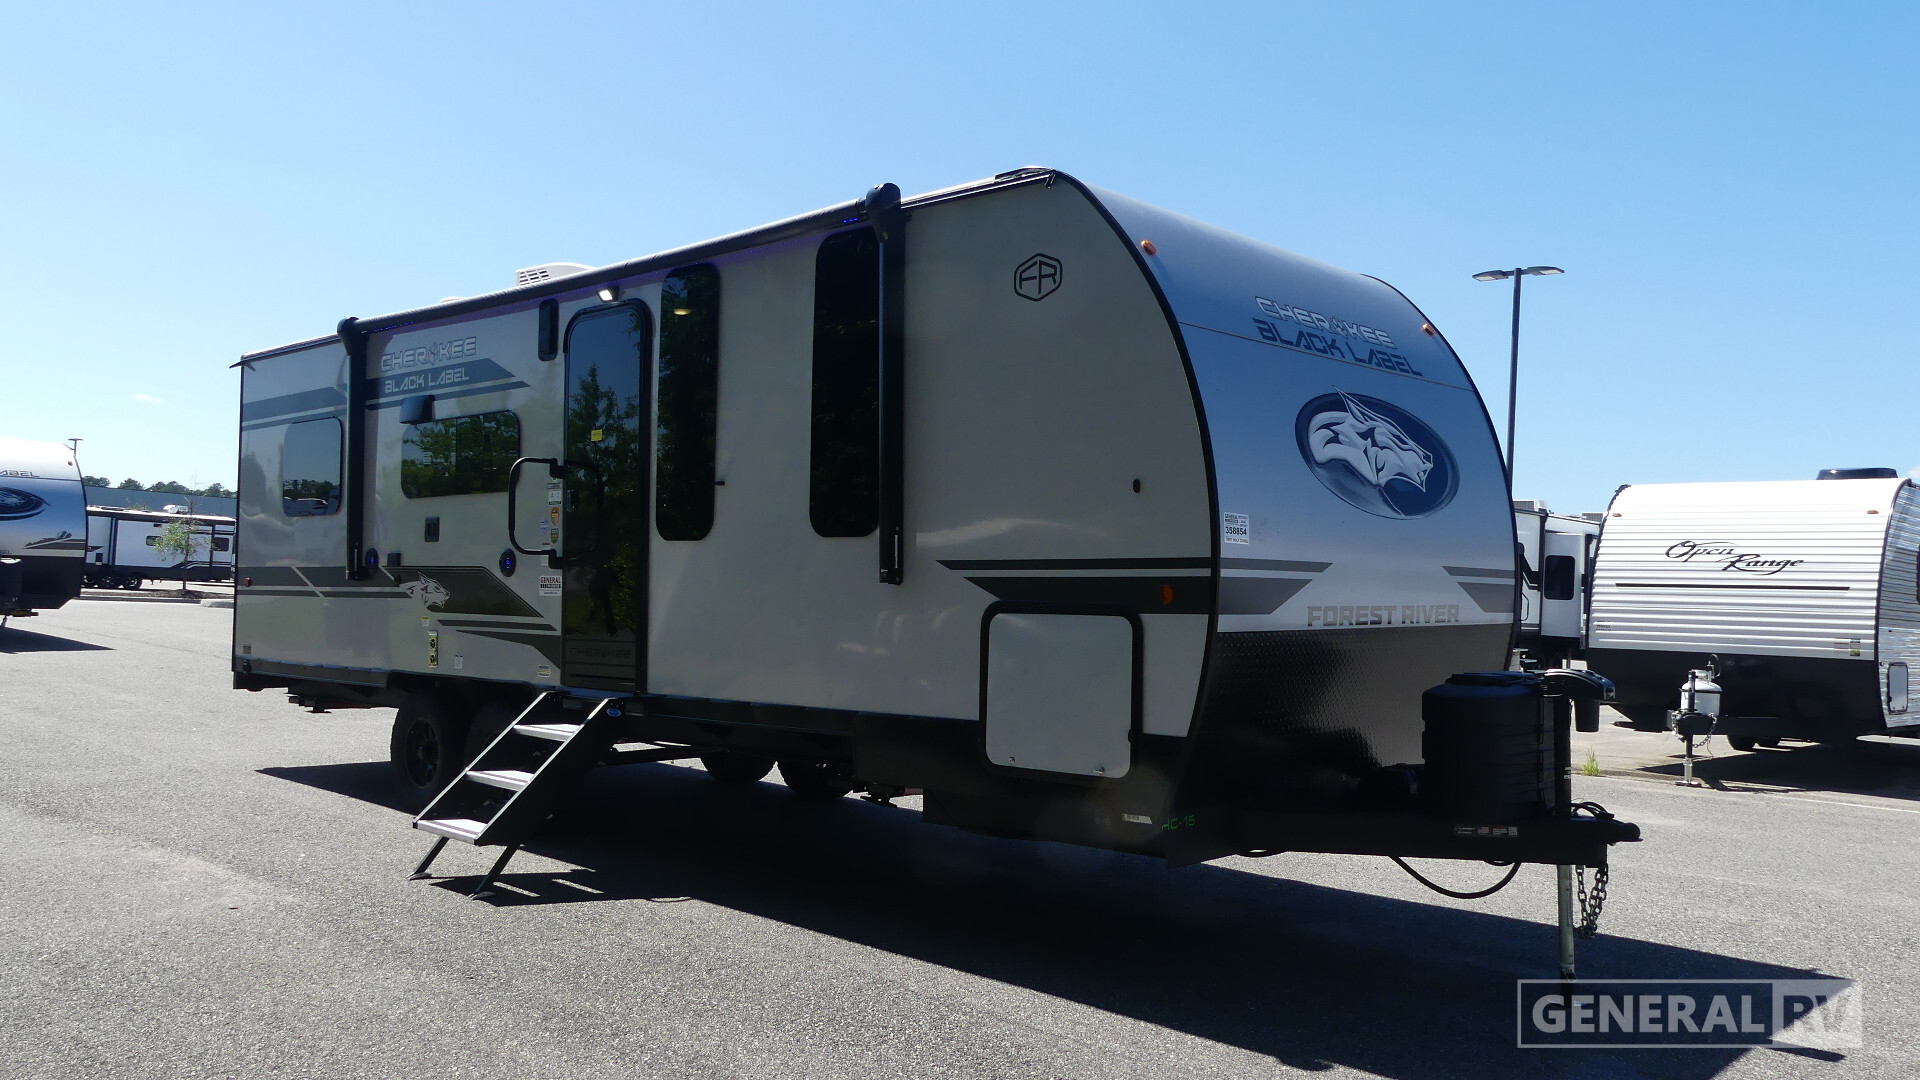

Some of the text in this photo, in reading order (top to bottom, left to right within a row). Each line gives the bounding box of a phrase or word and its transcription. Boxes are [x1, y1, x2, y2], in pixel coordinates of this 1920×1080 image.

[1254, 296, 1398, 350] CHEROKEE
[380, 336, 477, 373] CHEROKEE
[1252, 318, 1423, 377] BLACK LABEL
[385, 367, 470, 394] BLACK LABEL
[0, 469, 41, 478] ABEL
[1665, 540, 1805, 576] Open Range
[540, 576, 561, 584] GENERAL
[1306, 604, 1460, 627] FOREST RIVER
